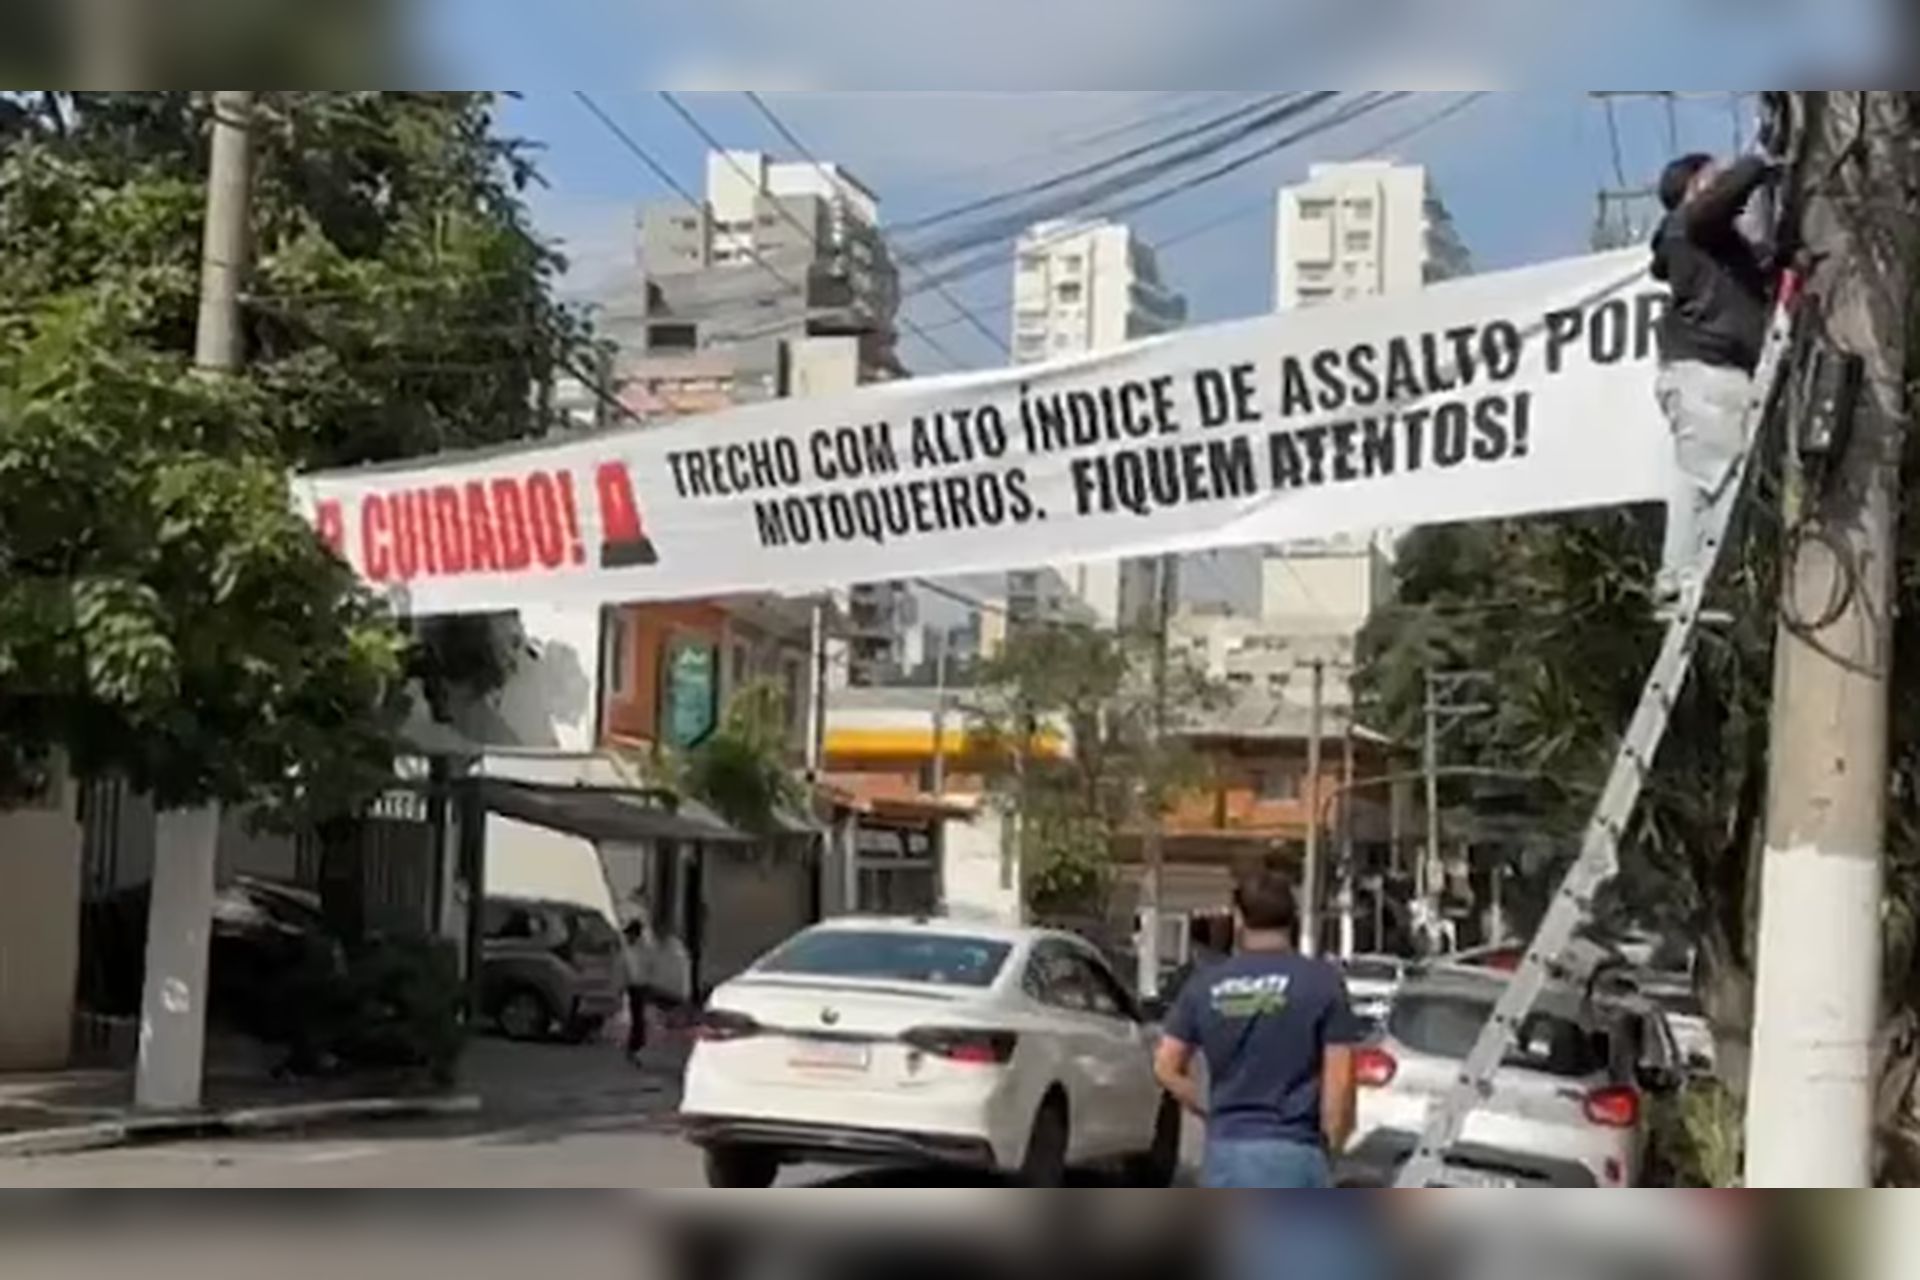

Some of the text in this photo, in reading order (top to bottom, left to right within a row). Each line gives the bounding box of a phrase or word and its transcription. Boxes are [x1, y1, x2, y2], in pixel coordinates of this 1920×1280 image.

[667, 435, 800, 498] TRECHO
[810, 422, 899, 483] COM
[911, 405, 1008, 470] ALTO
[1019, 376, 1180, 454] ÍNDICE
[1194, 363, 1261, 429] DE
[1281, 320, 1522, 417] ASSALTO
[755, 391, 1532, 548] MOTOQUEIROS. FIQUEM ATENTOS!
[361, 469, 586, 582] CUIDADO!
